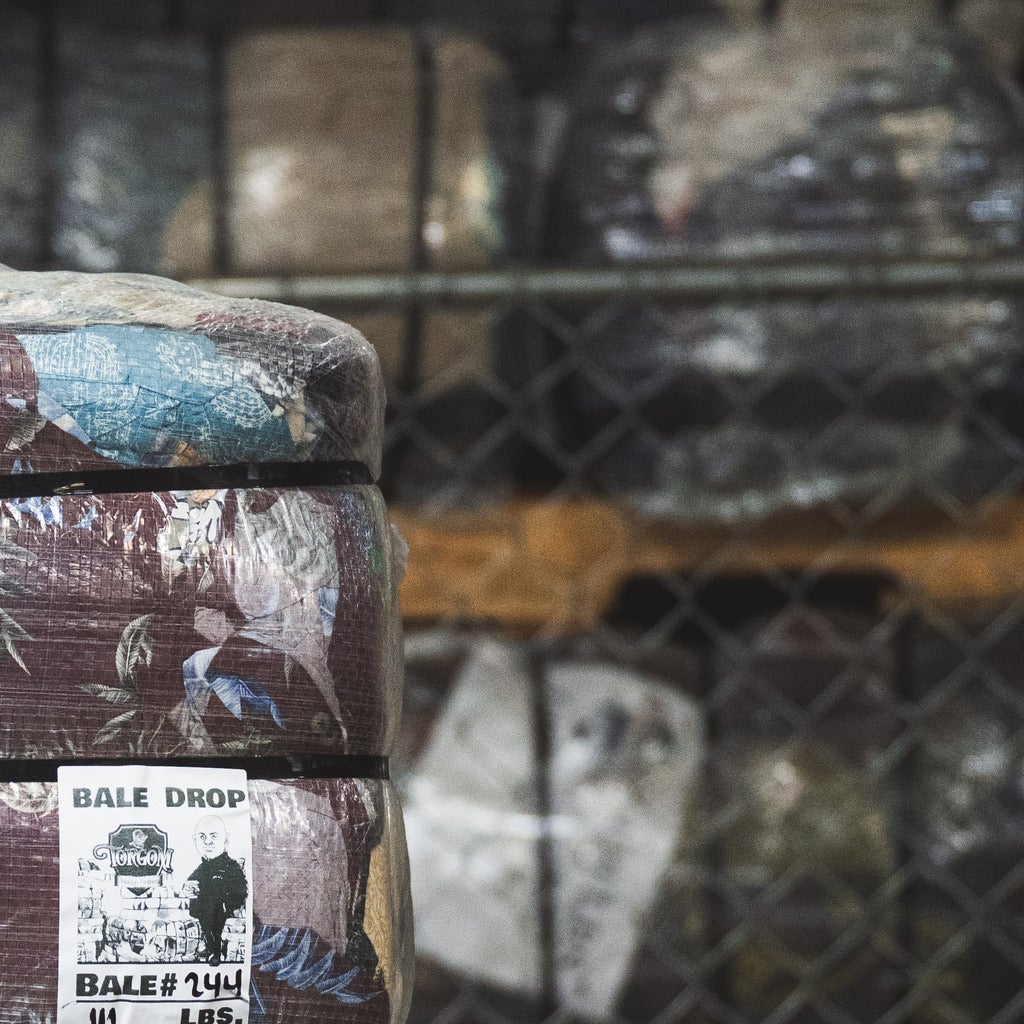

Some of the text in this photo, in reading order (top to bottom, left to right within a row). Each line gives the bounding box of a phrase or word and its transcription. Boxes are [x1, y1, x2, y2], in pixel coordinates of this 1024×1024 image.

[72, 787, 246, 808] BALE DROP
[93, 845, 174, 872] TORGOM
